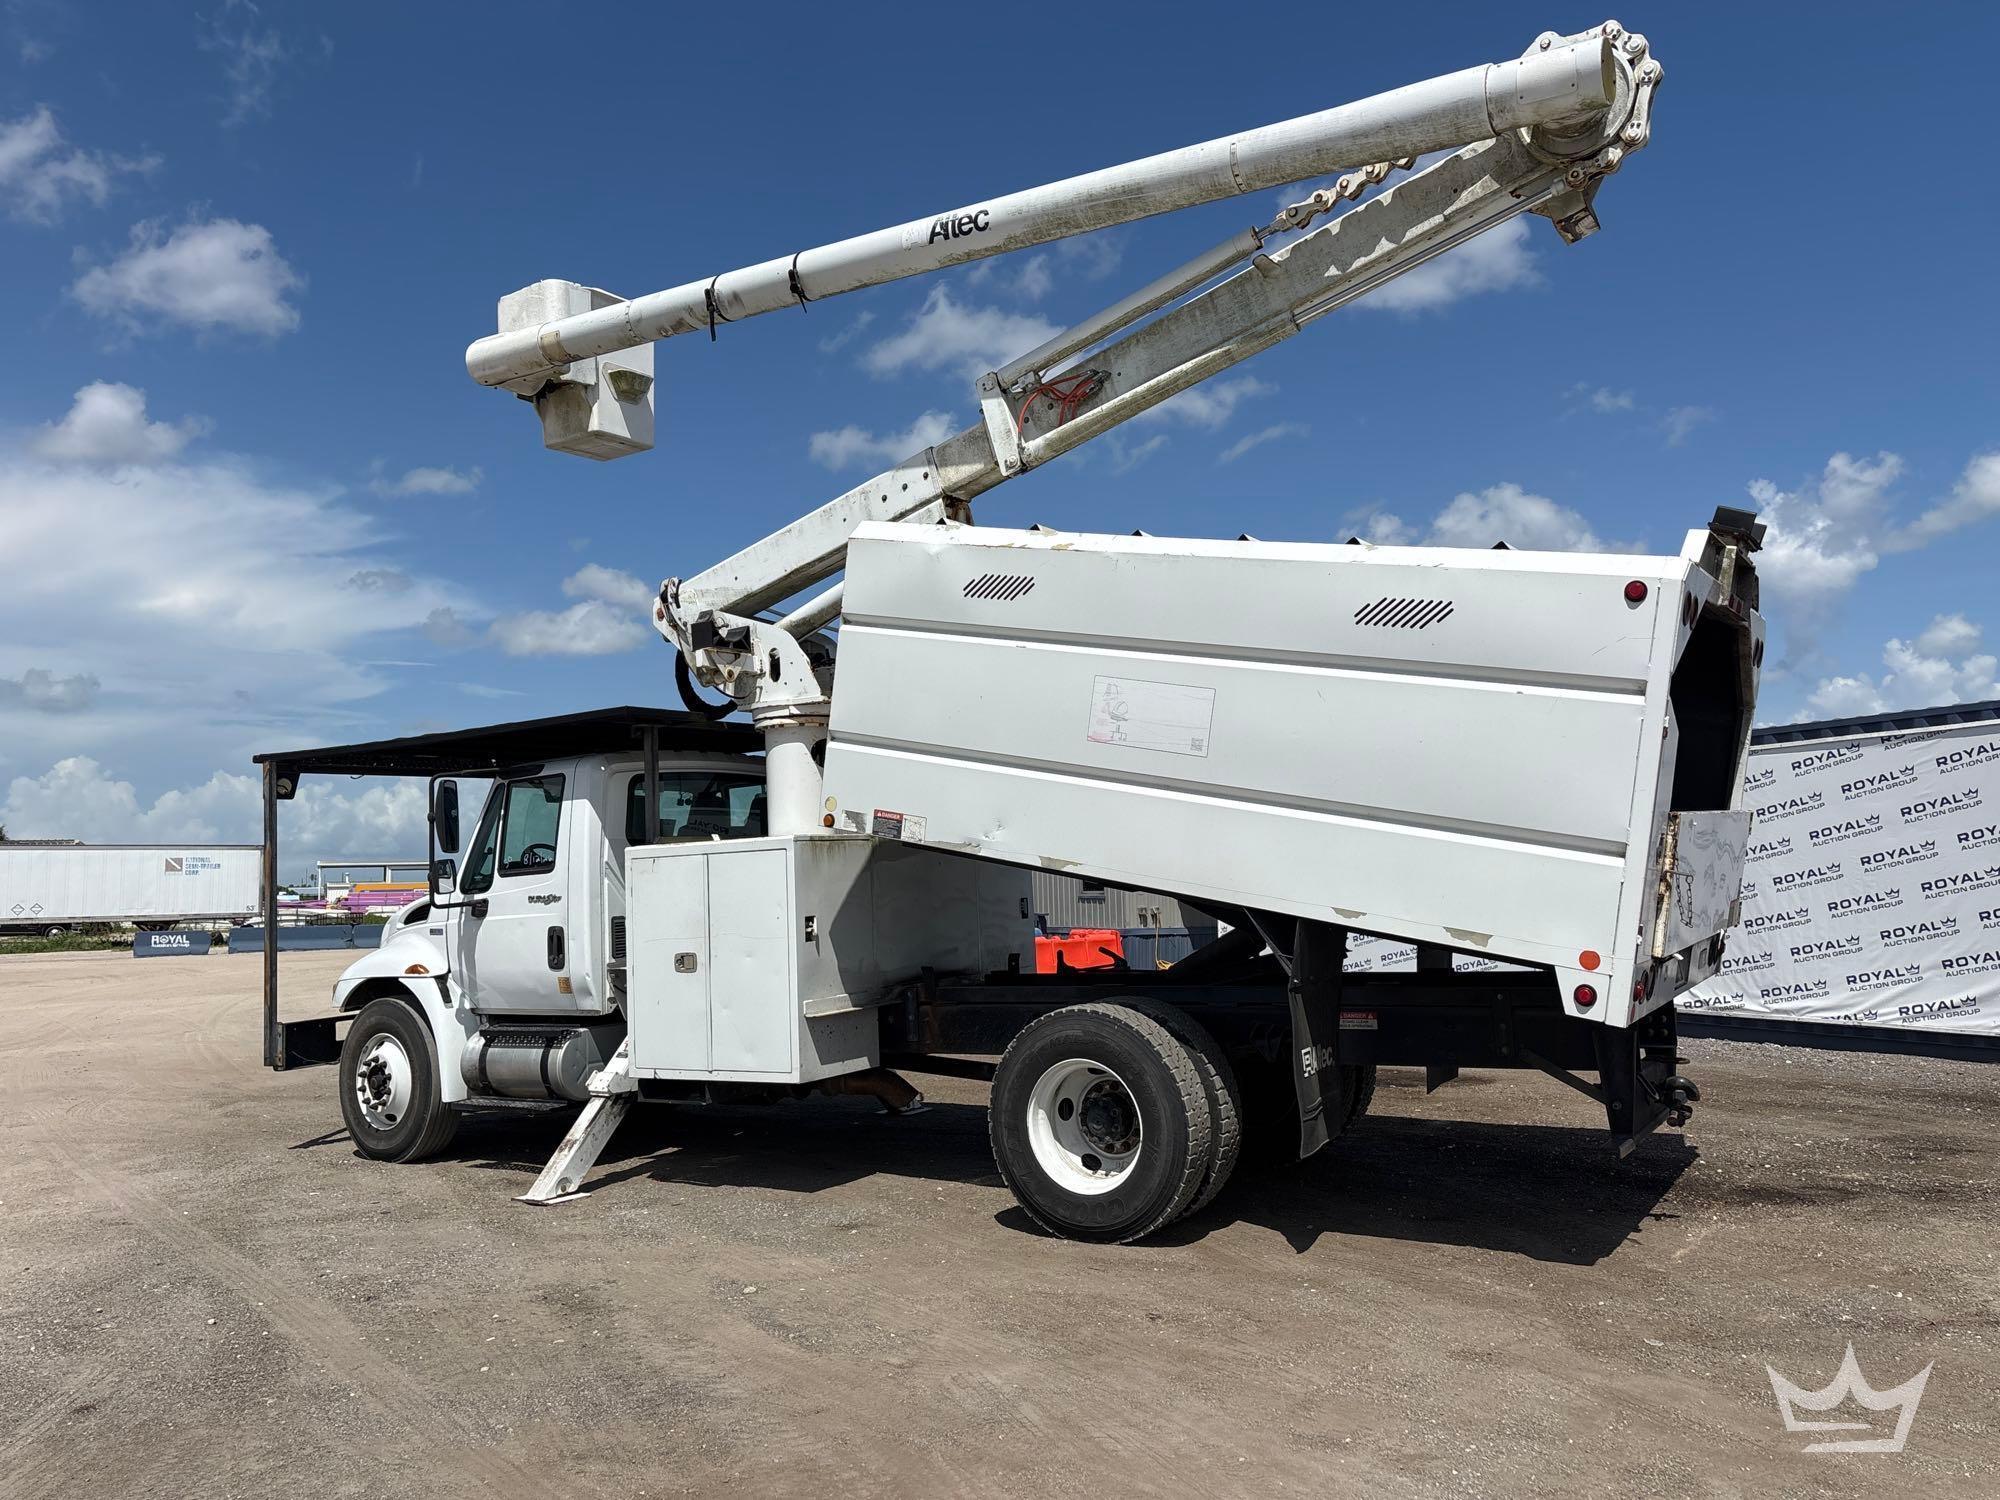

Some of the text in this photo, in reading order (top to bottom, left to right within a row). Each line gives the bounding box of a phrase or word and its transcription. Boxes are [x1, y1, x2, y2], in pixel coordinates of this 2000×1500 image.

[1884, 734, 1925, 751] AUCTION
[1791, 746, 1847, 771] ROYAL
[1936, 742, 2000, 768] ROYAL
[1794, 753, 1864, 778] AUCTION GROUP
[1939, 758, 1983, 775] AUCTION
[1749, 779, 1777, 792] GROUP
[1840, 771, 1900, 795] ROYAL
[1844, 776, 1918, 801] AUCTION GROUP
[1756, 797, 1809, 818] ROYAL
[1759, 802, 1825, 824] AUCTION GROUP
[1900, 793, 1964, 818] ROYAL
[1904, 799, 1983, 825] AUCTION GROUP
[881, 811, 901, 819] DANGER
[1809, 819, 1866, 841] ROYAL
[1812, 825, 1883, 848] AUCTION GROUP
[1957, 825, 2000, 844] ROY
[1745, 841, 1777, 857] YAL
[1765, 847, 1794, 859] GROUP
[1860, 845, 1921, 867] ROYAL
[1863, 851, 1939, 874] AUCTION GROUP
[1772, 867, 1827, 886] ROYAL
[1775, 873, 1844, 893] AUCTION GROUP
[1920, 871, 1985, 893] ROYAL
[1740, 892, 1758, 901] OUP
[1827, 892, 1886, 912] ROYAL
[1924, 886, 1968, 901] AUCTION
[1831, 899, 1904, 919] AUCTION GROUP
[1743, 911, 1796, 929] ROYAL
[1747, 918, 1812, 936] AUCTION GROUP
[151, 934, 190, 944] ROYAL
[1879, 921, 1942, 940] ROYAL
[1883, 929, 1961, 948] AUCTION GROUP
[1380, 949, 1411, 962] ROYAL
[1790, 939, 1847, 957] ROYAL
[1793, 946, 1863, 964] AUCTION GROUP
[1343, 961, 1365, 971] OYAL
[1455, 958, 1489, 972] ROYAL
[1722, 954, 1761, 969] OYAL
[1748, 962, 1776, 972] GROUP
[1846, 967, 1906, 986] ROYAL
[1945, 965, 1989, 978] AUCTION
[1760, 982, 1814, 999] ROYAL
[1849, 975, 1924, 993] AUCTION GROUP
[1683, 995, 1731, 1009] ROYAL
[1763, 990, 1830, 1006] AUCTION GROUP
[1898, 999, 1962, 1017] ROYAL
[1901, 1008, 1981, 1024] AUCTION GROUP
